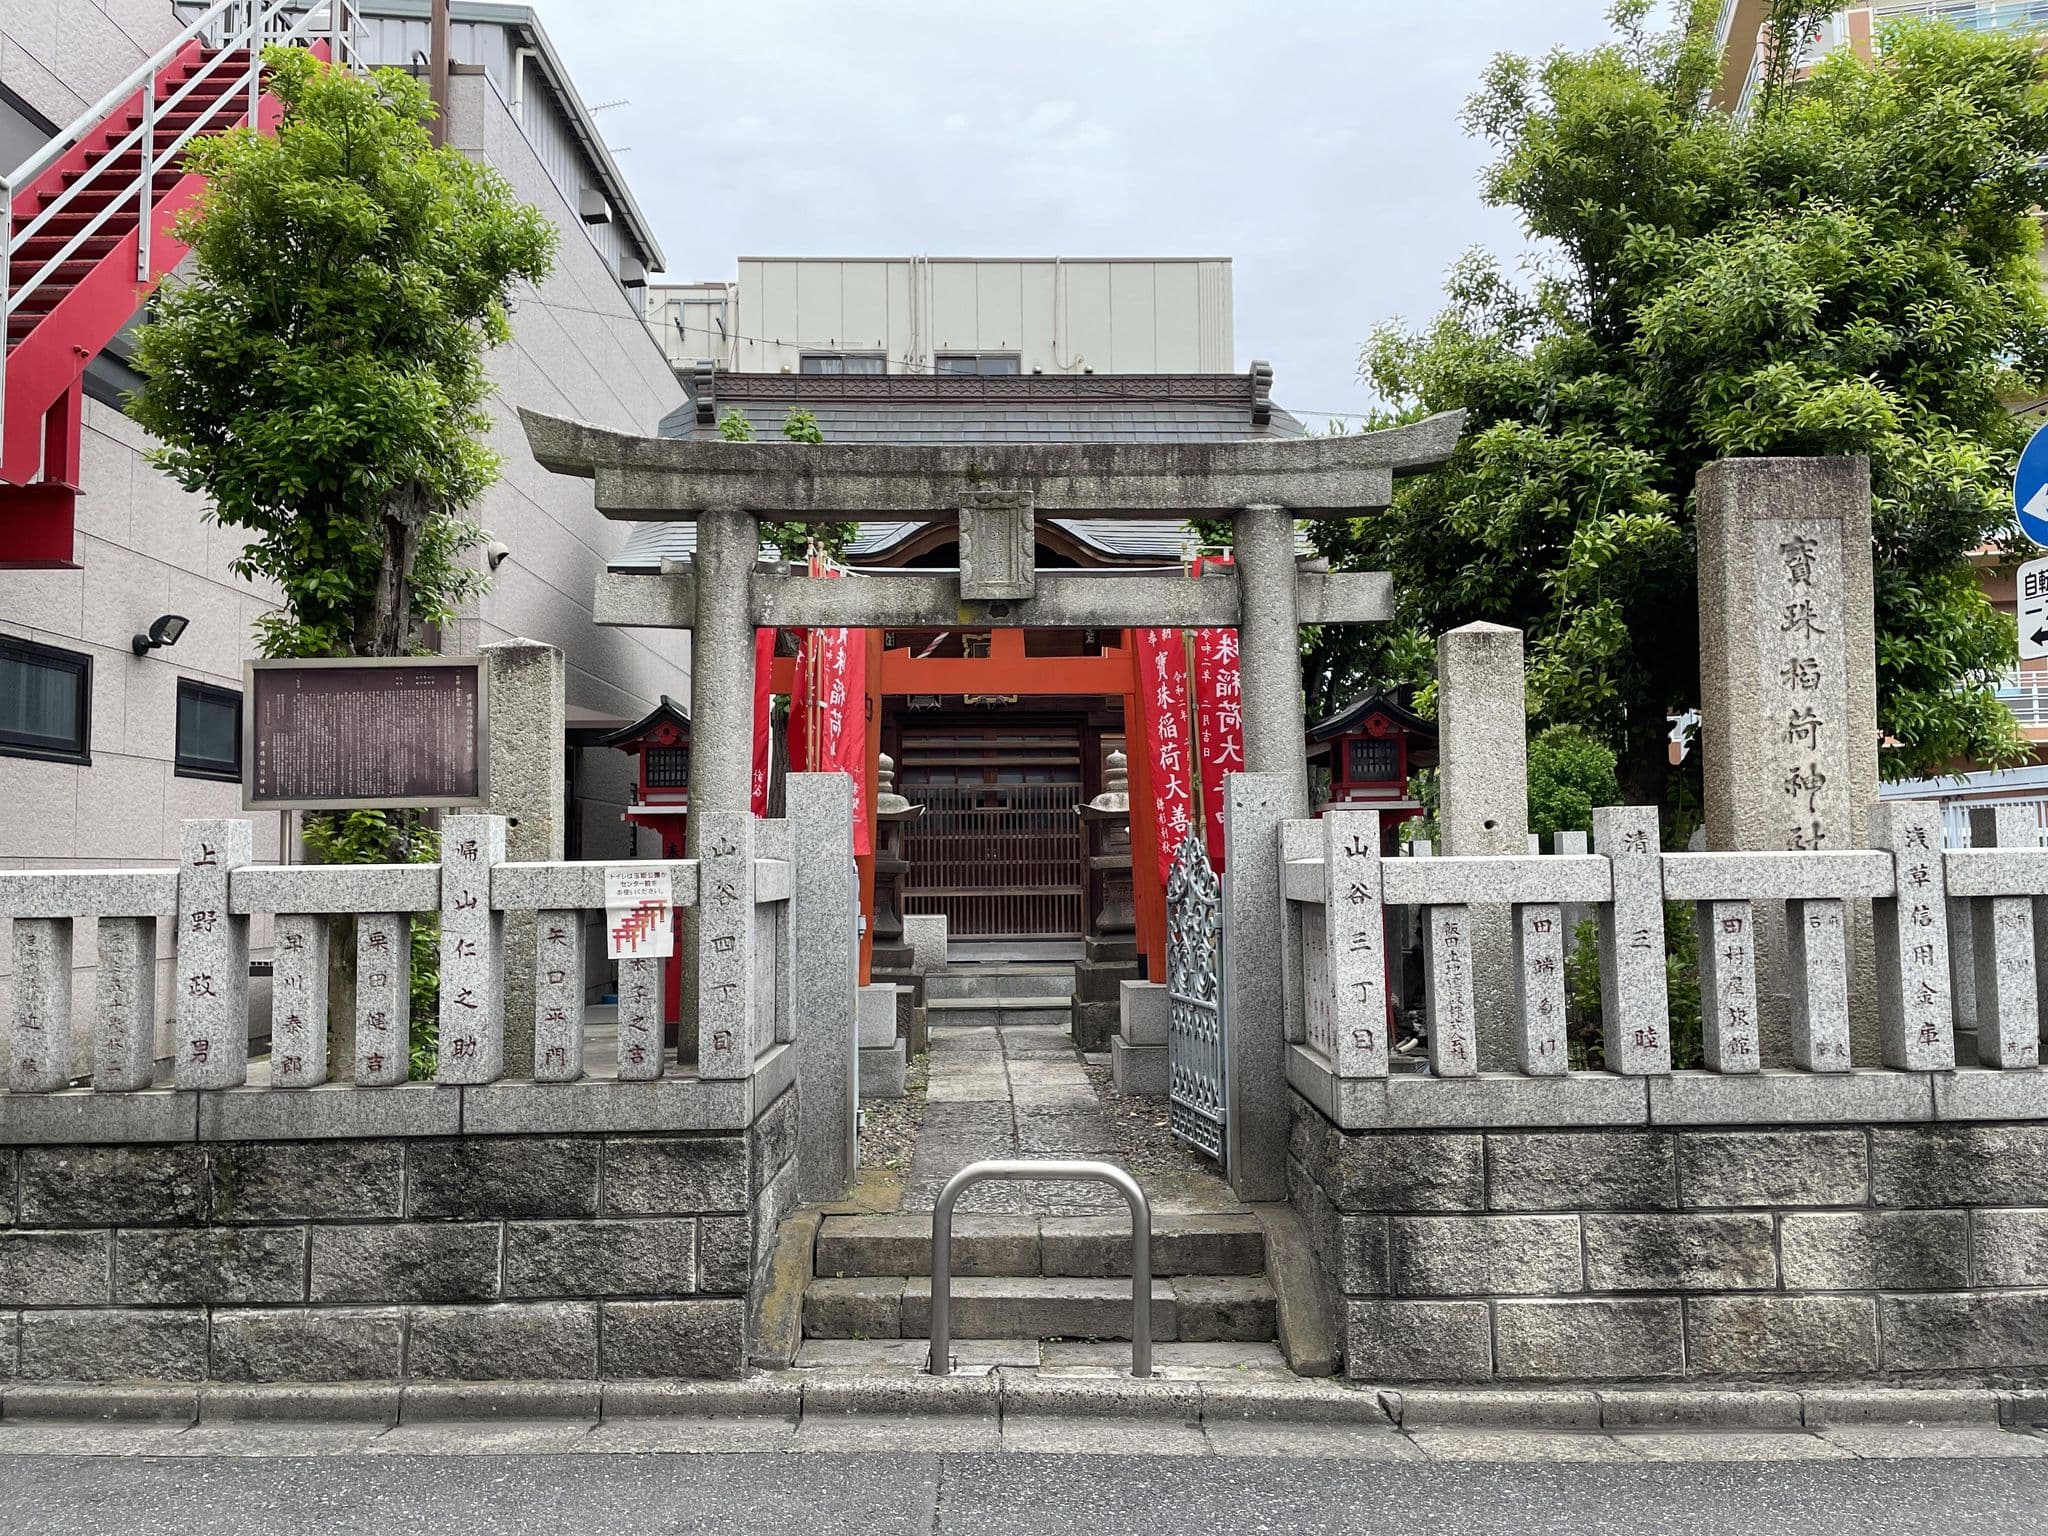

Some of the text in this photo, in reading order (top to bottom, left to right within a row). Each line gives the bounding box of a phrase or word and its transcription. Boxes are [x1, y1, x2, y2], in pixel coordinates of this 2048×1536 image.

[189, 843, 217, 1064] 上野政男
[711, 837, 738, 1053] 山谷四丁目
[1344, 835, 1375, 1052] 山谷三丁目
[1906, 826, 1940, 1047] 浅草信用金庫
